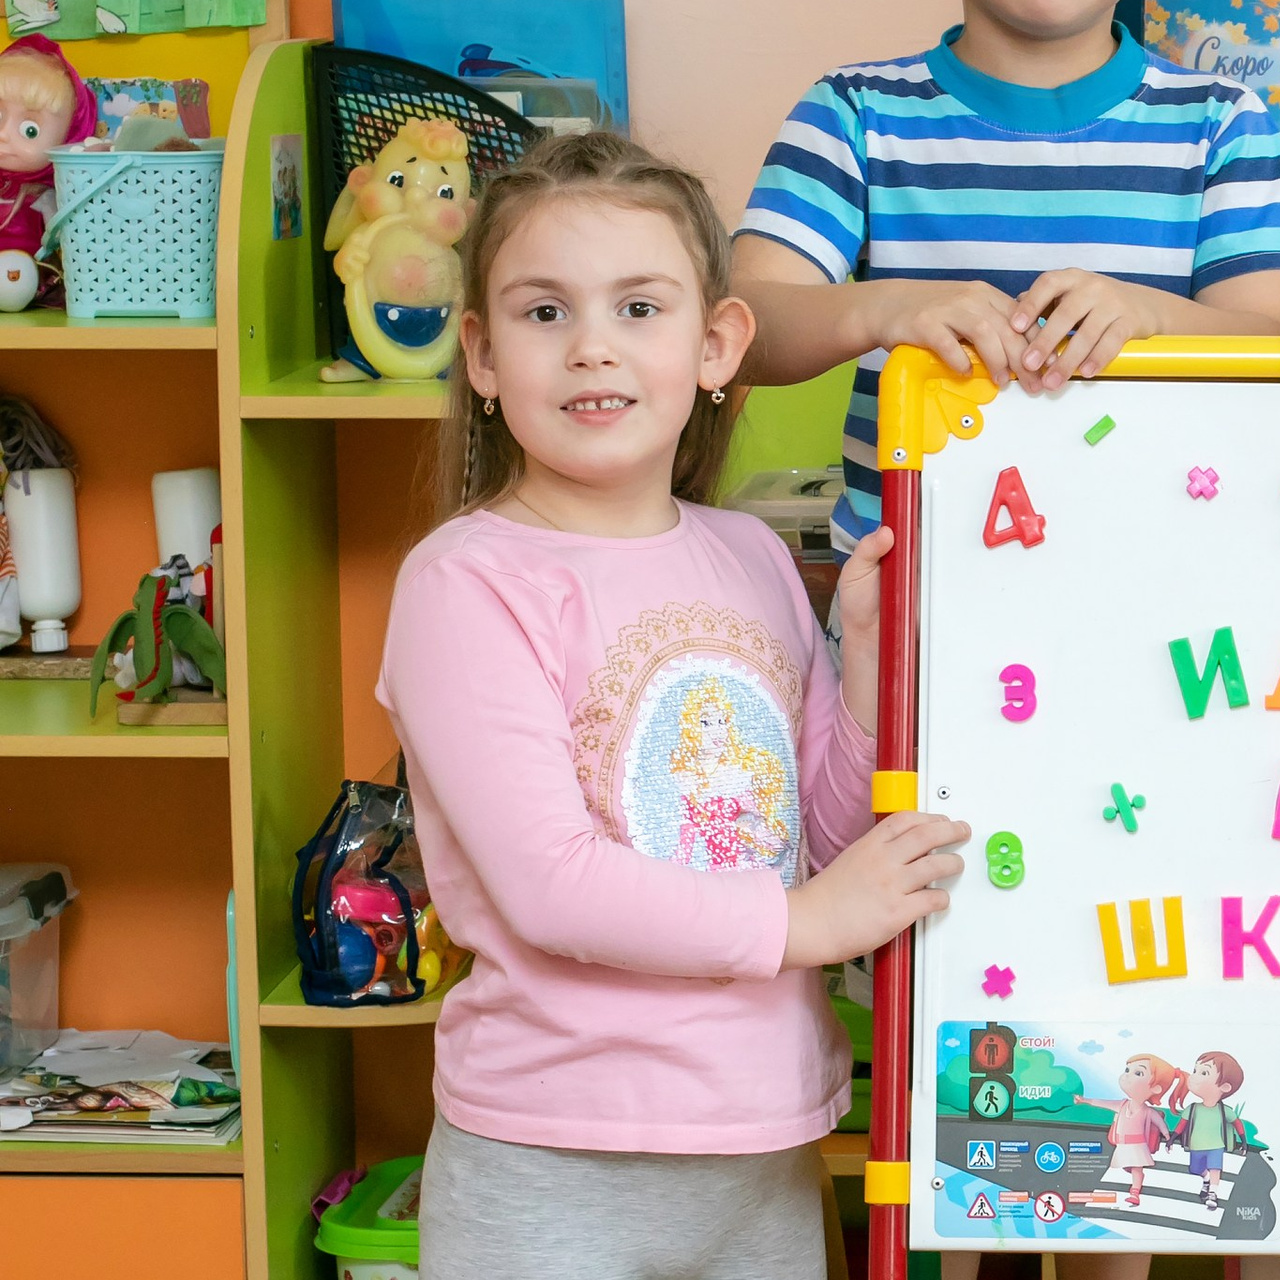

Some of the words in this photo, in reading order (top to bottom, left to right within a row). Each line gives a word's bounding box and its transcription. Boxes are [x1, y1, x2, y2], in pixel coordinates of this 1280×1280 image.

[1194, 36, 1274, 82] Скоро
[986, 831, 1025, 889] 8
[1020, 1036, 1055, 1047] СТОЙ!
[1020, 1087, 1050, 1098] ИДИ!
